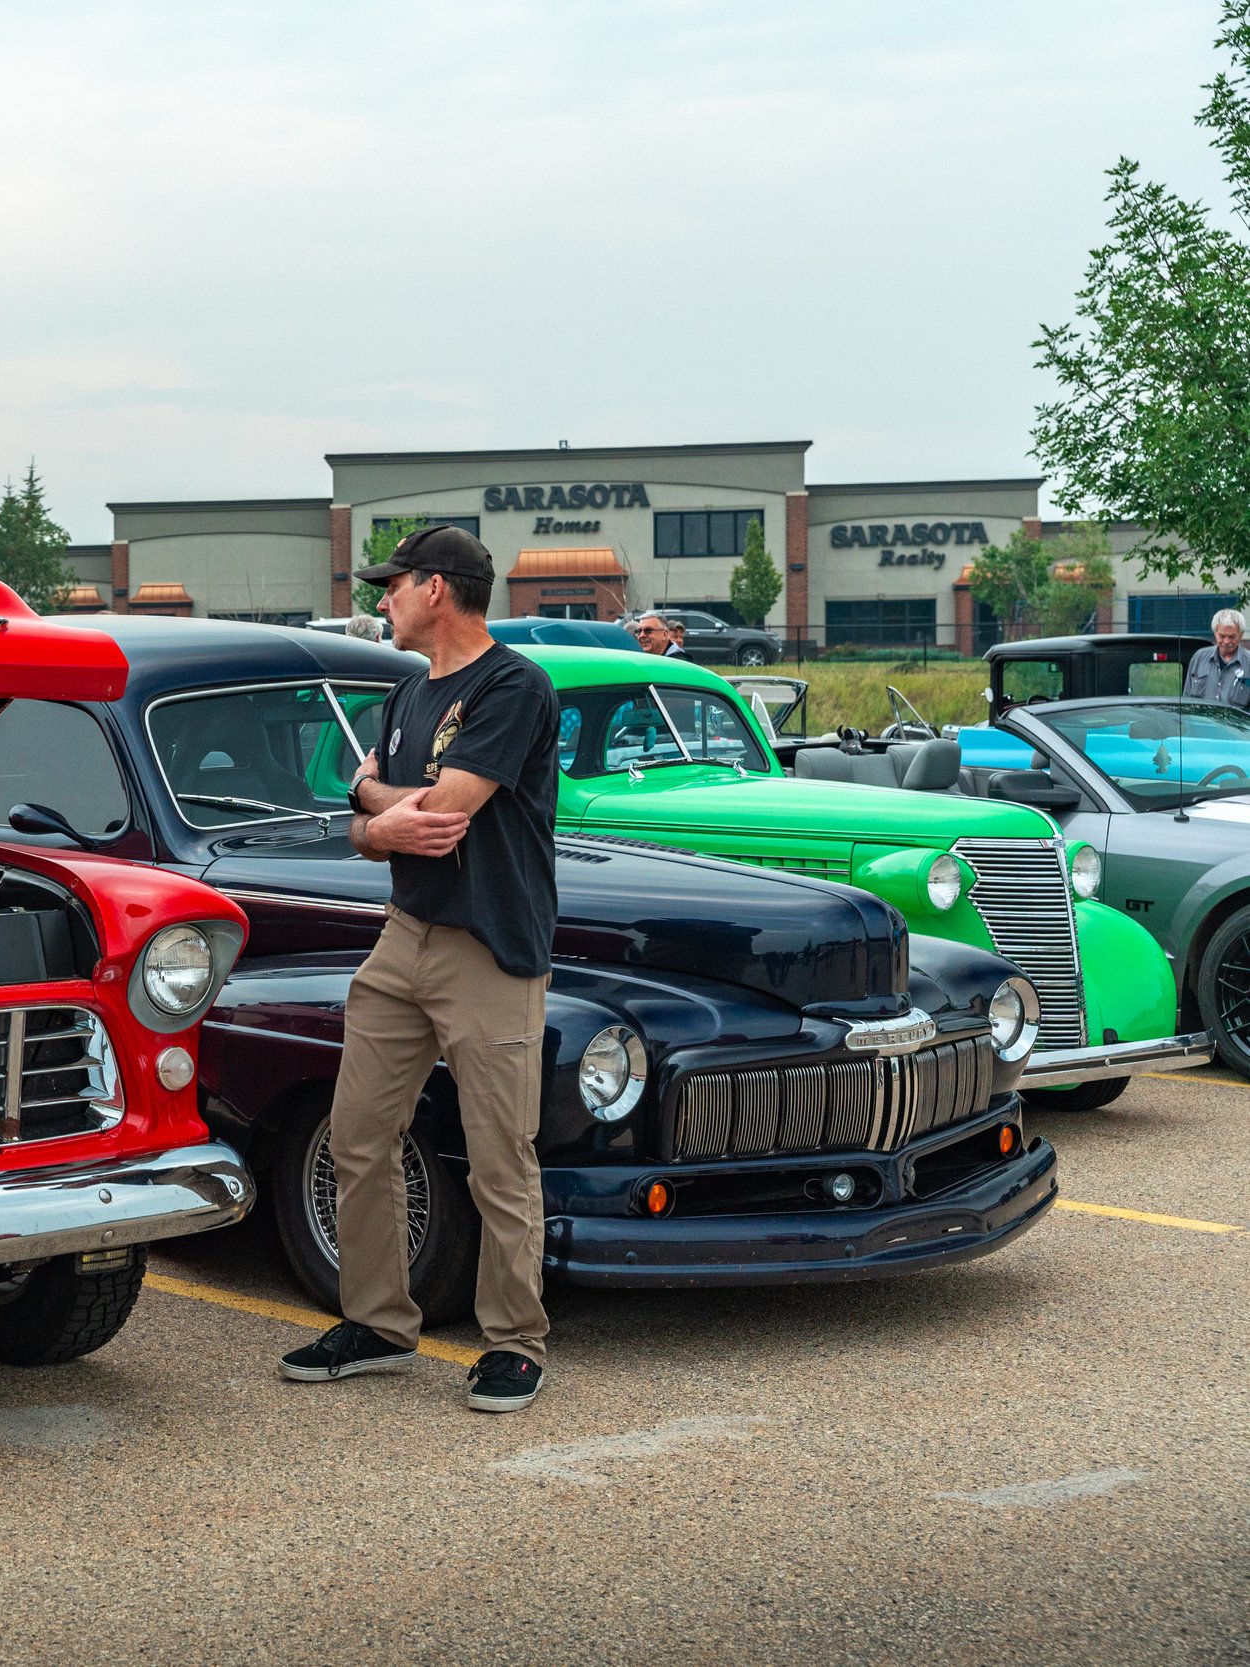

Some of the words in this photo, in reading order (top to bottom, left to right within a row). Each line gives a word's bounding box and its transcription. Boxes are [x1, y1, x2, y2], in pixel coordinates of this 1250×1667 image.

[484, 484, 651, 512] SARASOTA
[532, 517, 601, 535] Homes
[831, 522, 989, 548] SARASOTA
[878, 549, 946, 571] Realty
[1125, 898, 1155, 913] GT
[856, 1026, 930, 1045] MERCURY
